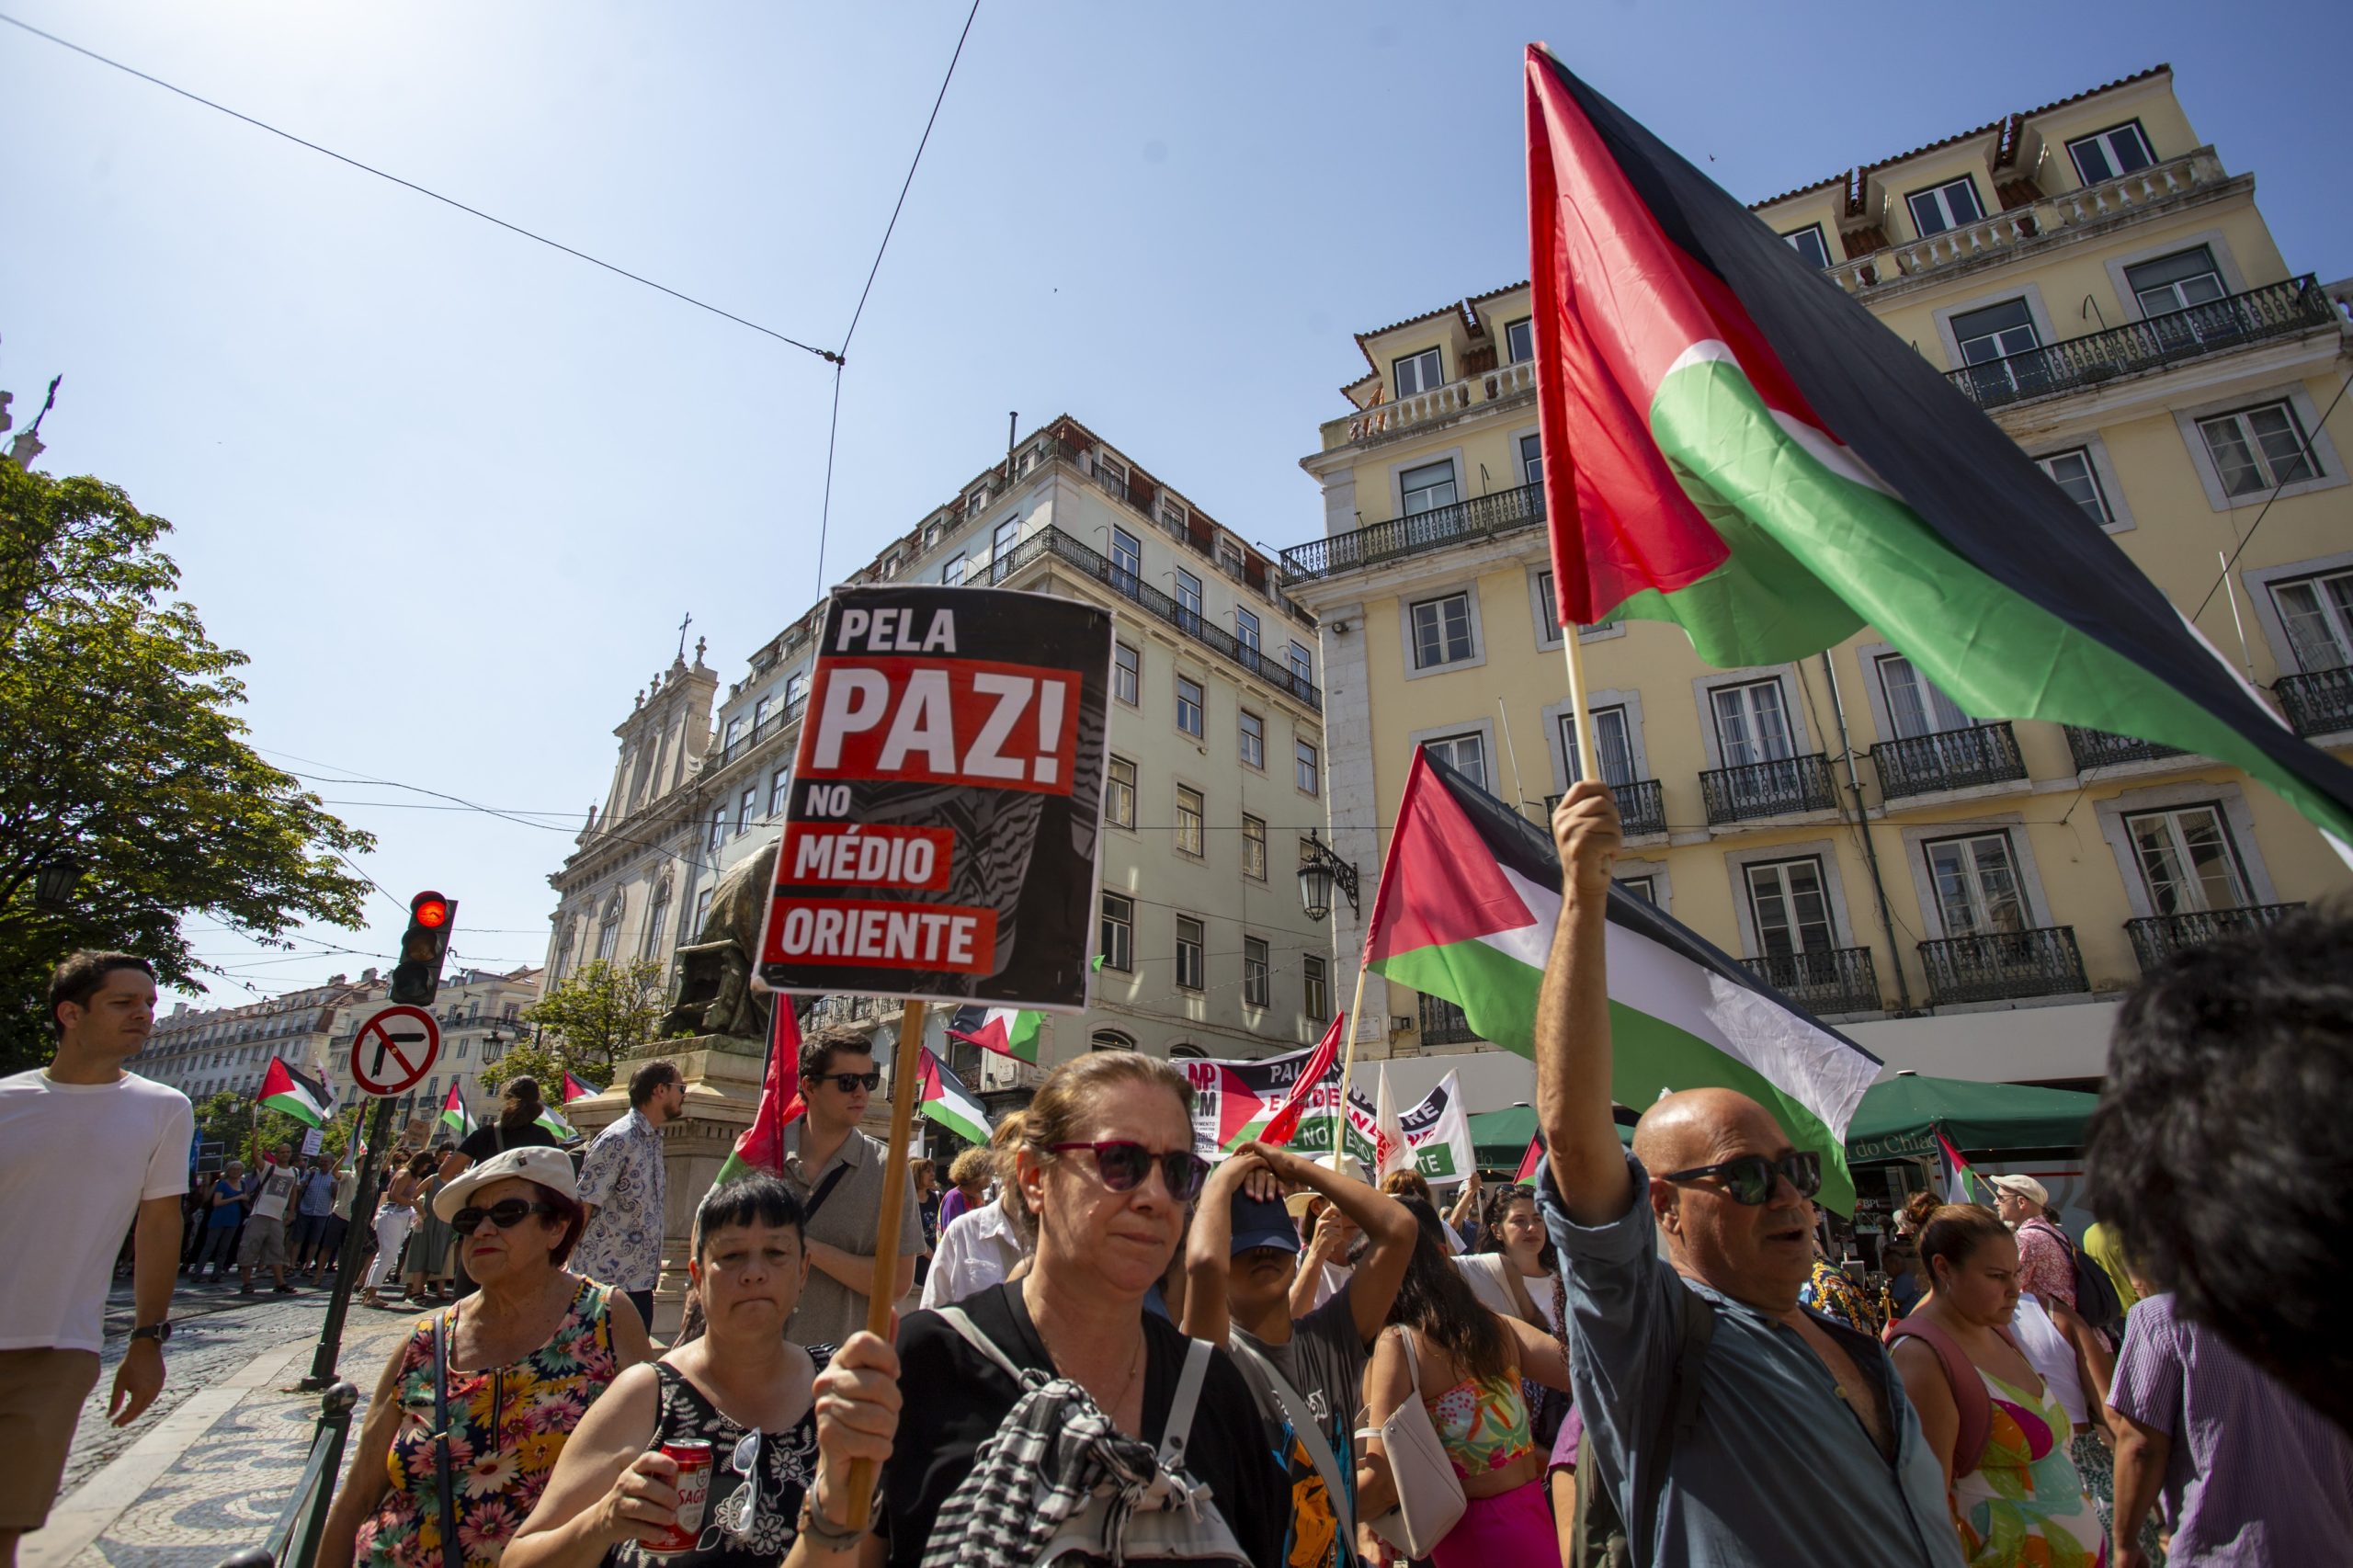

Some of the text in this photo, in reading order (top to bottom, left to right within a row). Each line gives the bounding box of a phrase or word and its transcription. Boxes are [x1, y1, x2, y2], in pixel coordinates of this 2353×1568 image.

[835, 608, 957, 653] PELA
[812, 667, 1066, 784] PAZ!
[804, 784, 851, 817] NO
[793, 824, 936, 884] MÉDIO
[780, 906, 978, 964] ORIENTE
[1302, 1126, 1328, 1146] NO
[1855, 1140, 1880, 1158] do
[677, 1488, 707, 1506] SAGR
